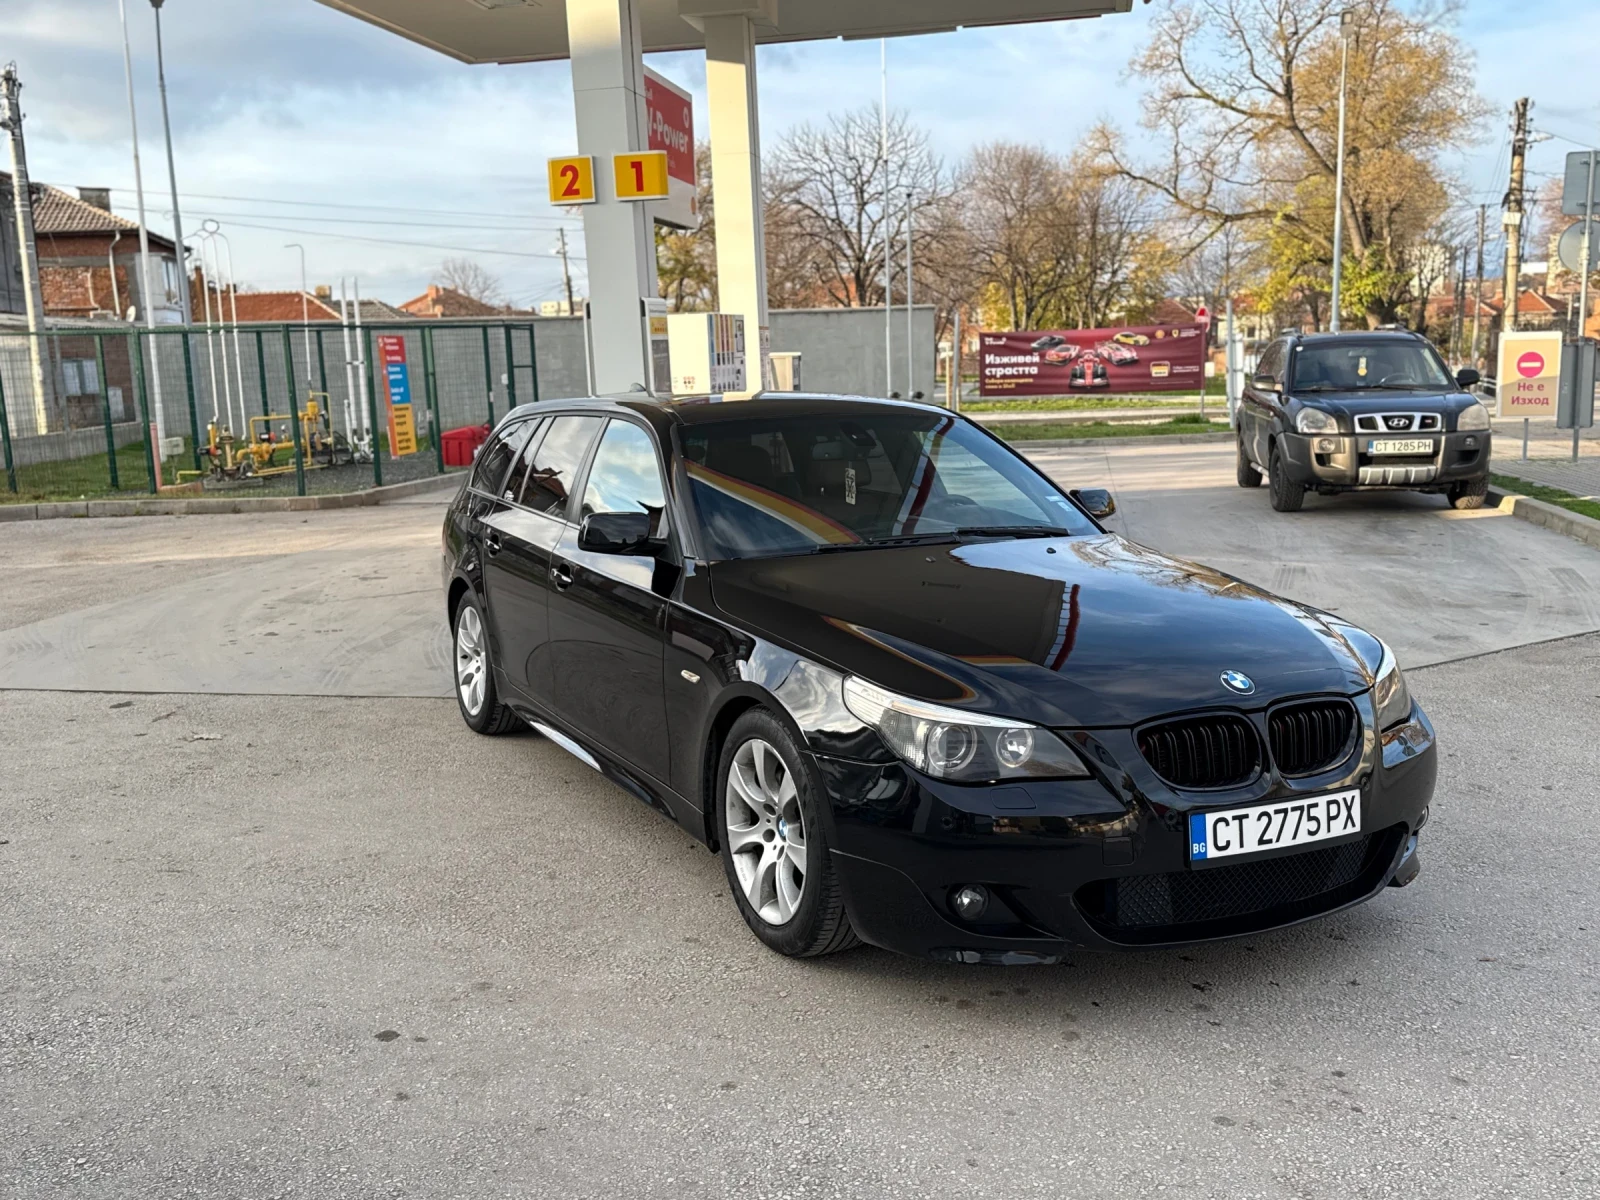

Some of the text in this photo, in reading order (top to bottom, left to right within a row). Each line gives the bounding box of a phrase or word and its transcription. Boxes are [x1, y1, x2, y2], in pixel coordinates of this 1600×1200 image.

[559, 164, 580, 197] 2
[630, 160, 644, 192] 1
[985, 352, 1040, 365] Изживей
[985, 366, 1038, 378] страстта
[1517, 382, 1545, 391] Не е
[1511, 395, 1549, 406] Изход
[1212, 813, 1250, 852] CT
[1256, 802, 1321, 847] 2775
[1193, 842, 1206, 854] BG
